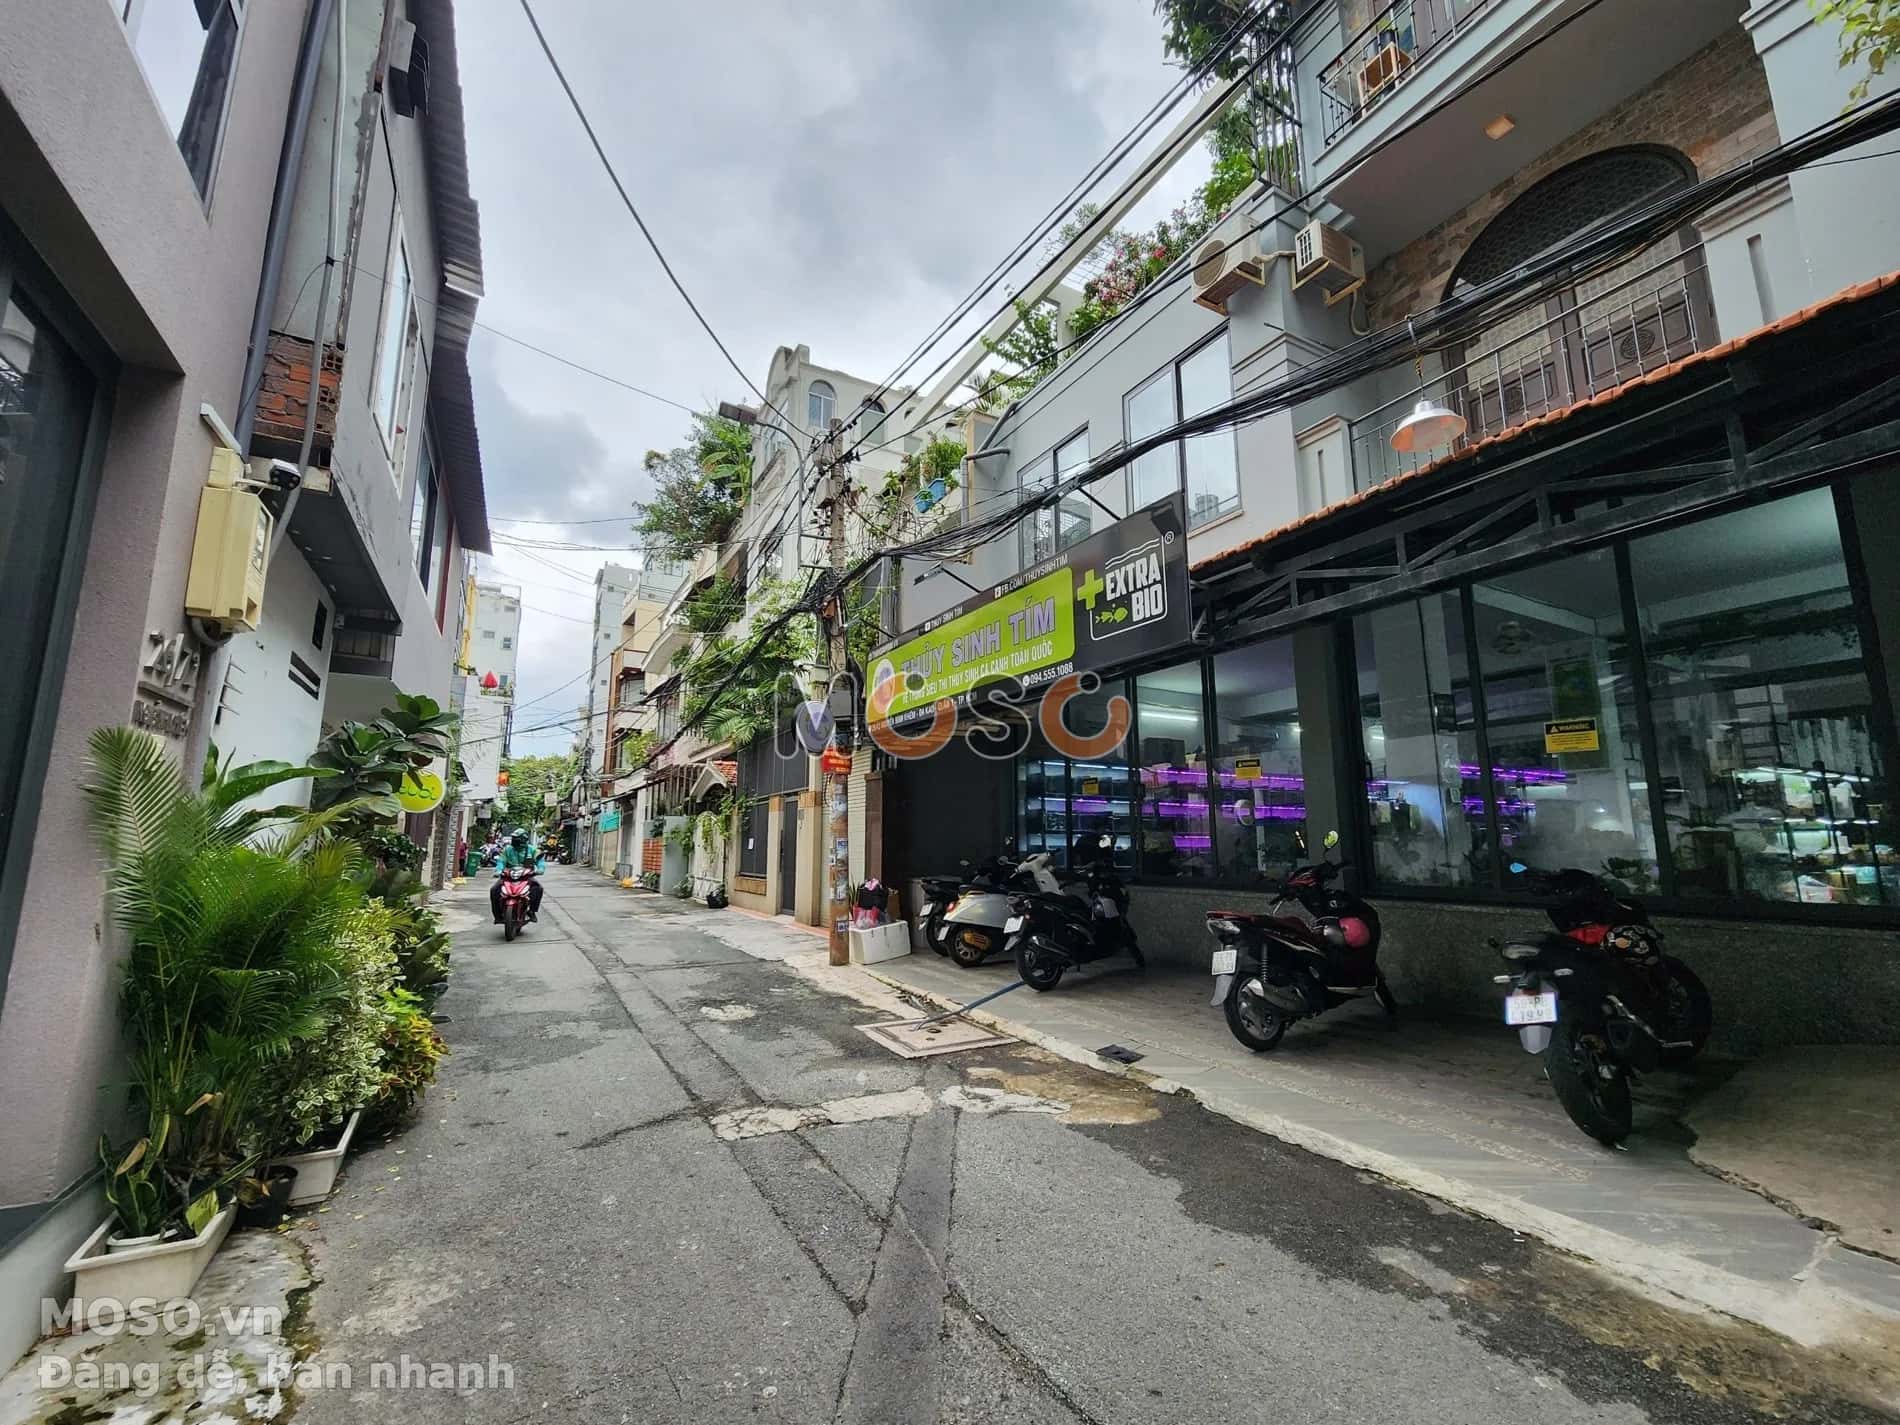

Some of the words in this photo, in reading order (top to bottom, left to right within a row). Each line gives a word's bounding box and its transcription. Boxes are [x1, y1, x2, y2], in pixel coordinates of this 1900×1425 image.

[1105, 552, 1161, 601] EXTRA
[1131, 583, 1164, 622] BIO
[952, 619, 1001, 668] SINH
[1008, 595, 1056, 646] TÍM
[1030, 661, 1073, 685] 094.555.1088
